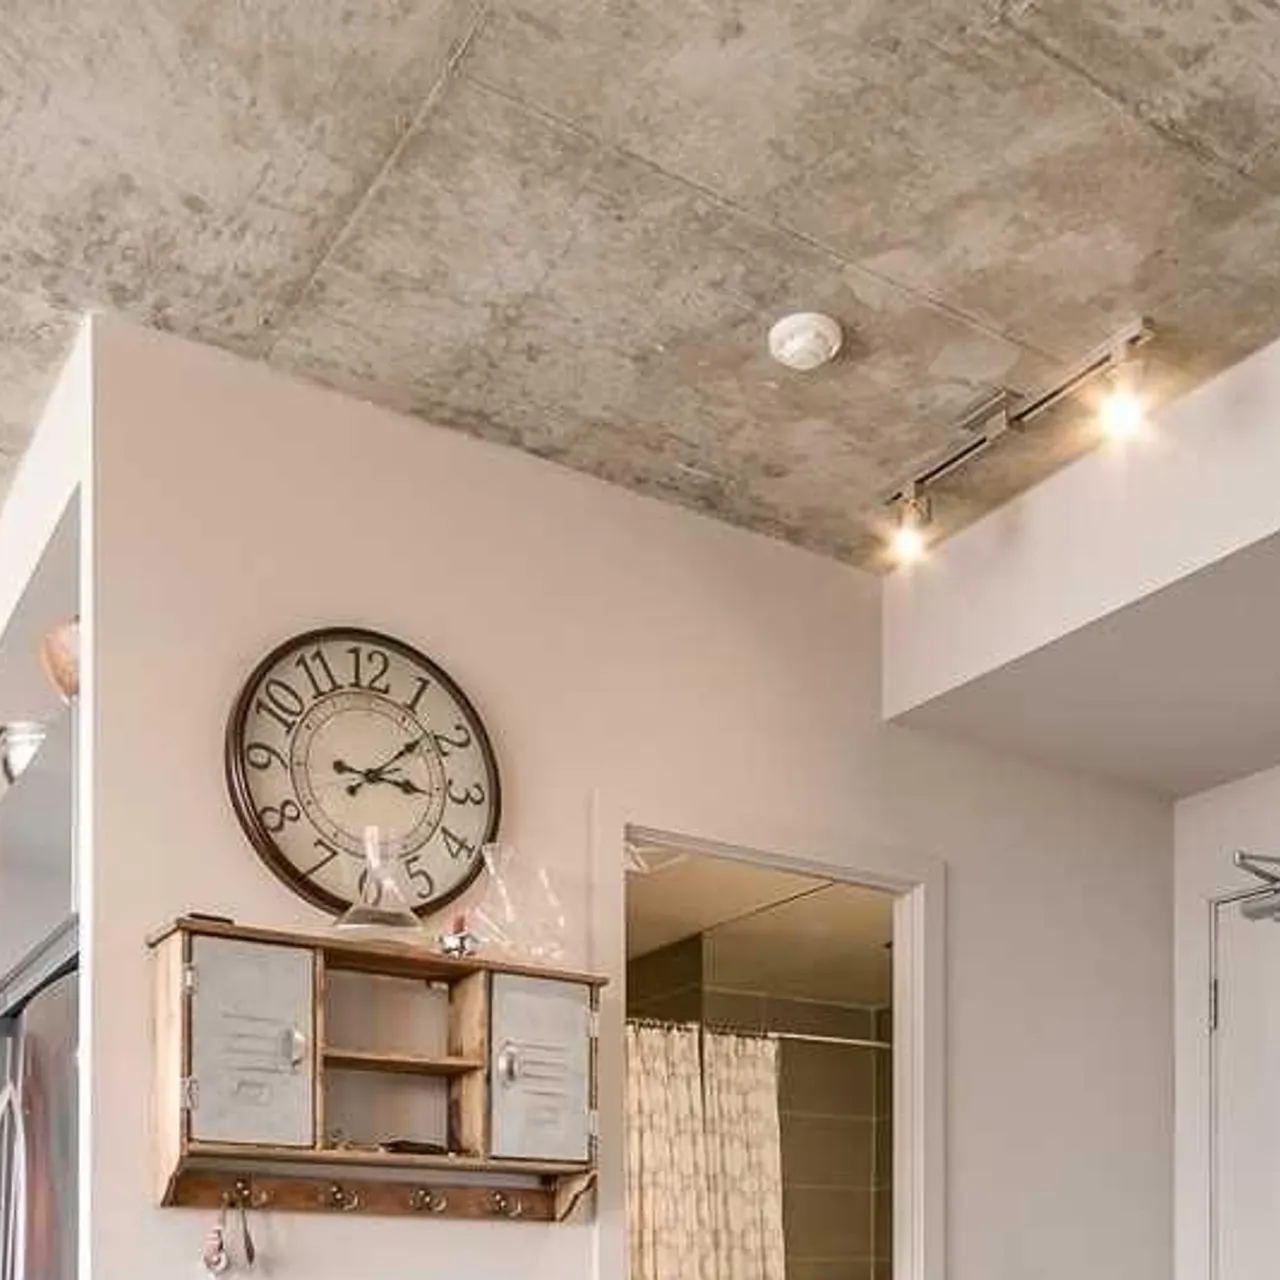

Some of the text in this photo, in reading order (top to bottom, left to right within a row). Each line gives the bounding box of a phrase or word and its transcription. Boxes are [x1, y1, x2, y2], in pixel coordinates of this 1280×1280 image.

[295, 650, 343, 699] 11
[346, 647, 391, 695] 12
[256, 679, 305, 734] 10
[403, 676, 431, 714] 1
[246, 742, 288, 771] 9
[432, 724, 471, 757] 2
[447, 779, 485, 806] 3
[261, 800, 301, 834] 8
[299, 839, 338, 882] 7
[440, 825, 475, 860] 4
[405, 856, 435, 899] 5
